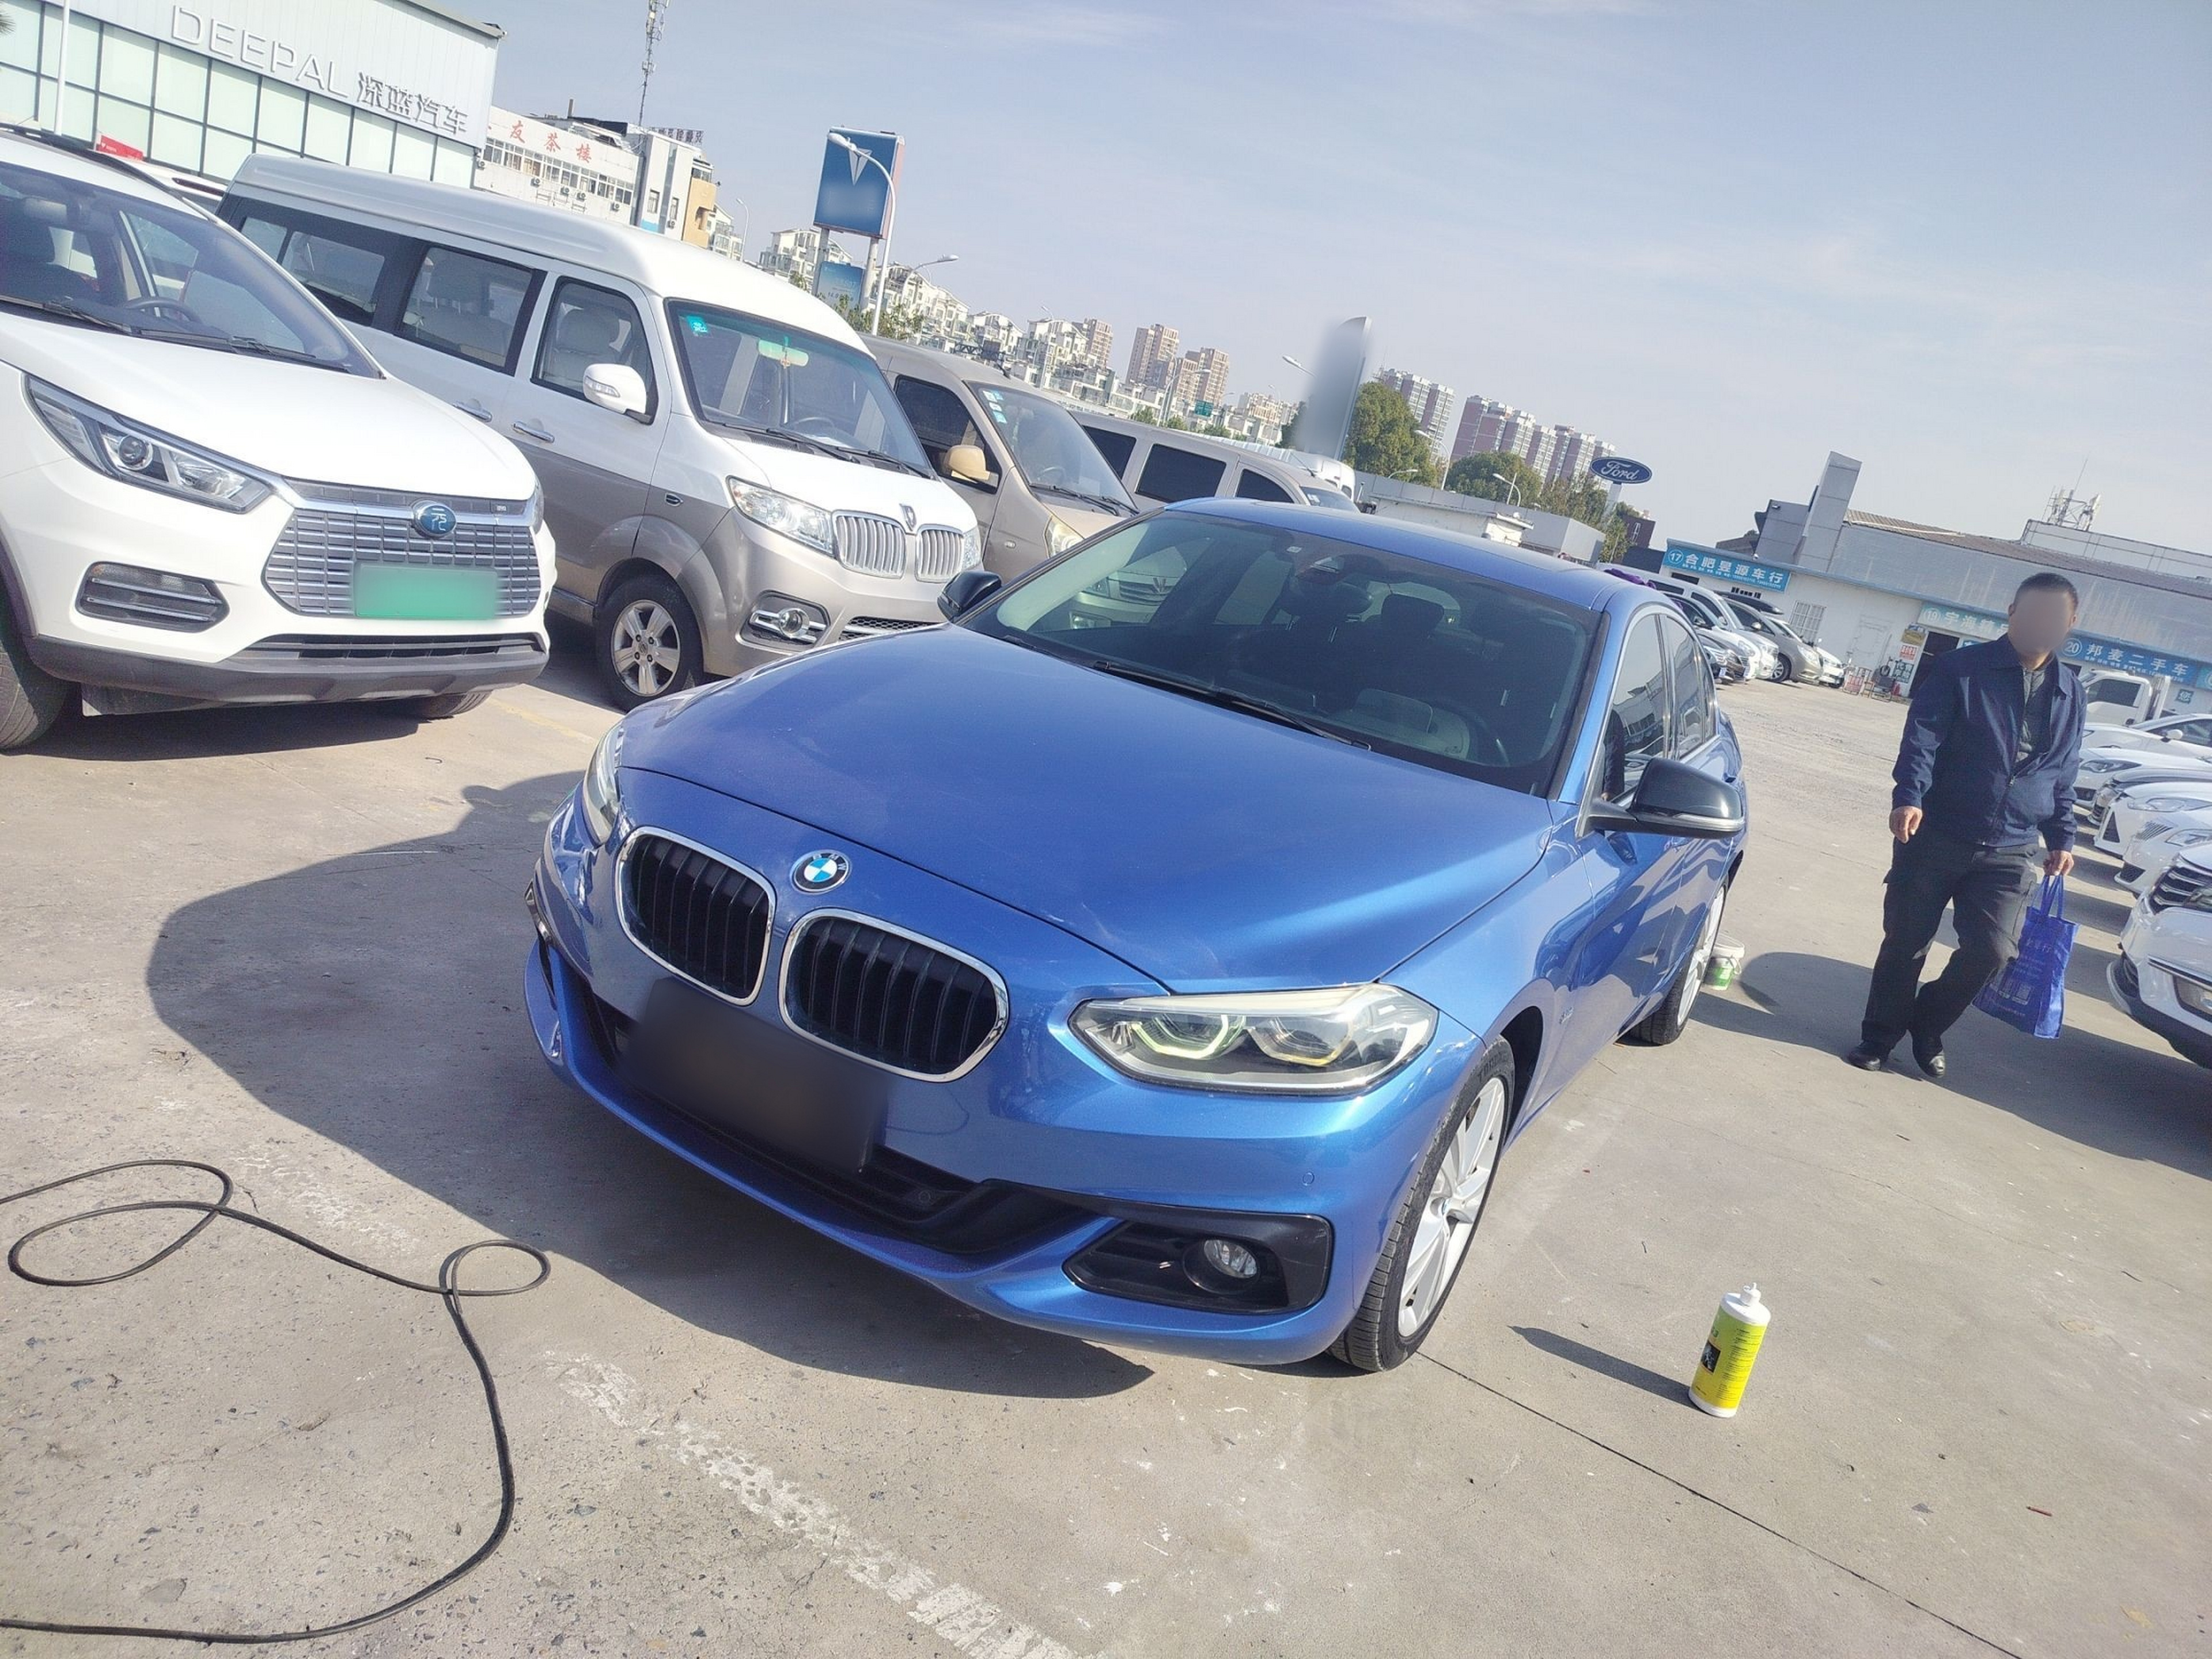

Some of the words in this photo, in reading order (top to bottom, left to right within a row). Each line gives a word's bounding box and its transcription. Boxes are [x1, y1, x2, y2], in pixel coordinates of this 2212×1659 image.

[171, 5, 348, 98] DEEPAL
[357, 72, 468, 134] 深蓝汽车
[488, 120, 592, 164] 友茶楼
[1601, 460, 1639, 480] Ford
[1669, 550, 1683, 562] 17
[2065, 640, 2080, 654] 20
